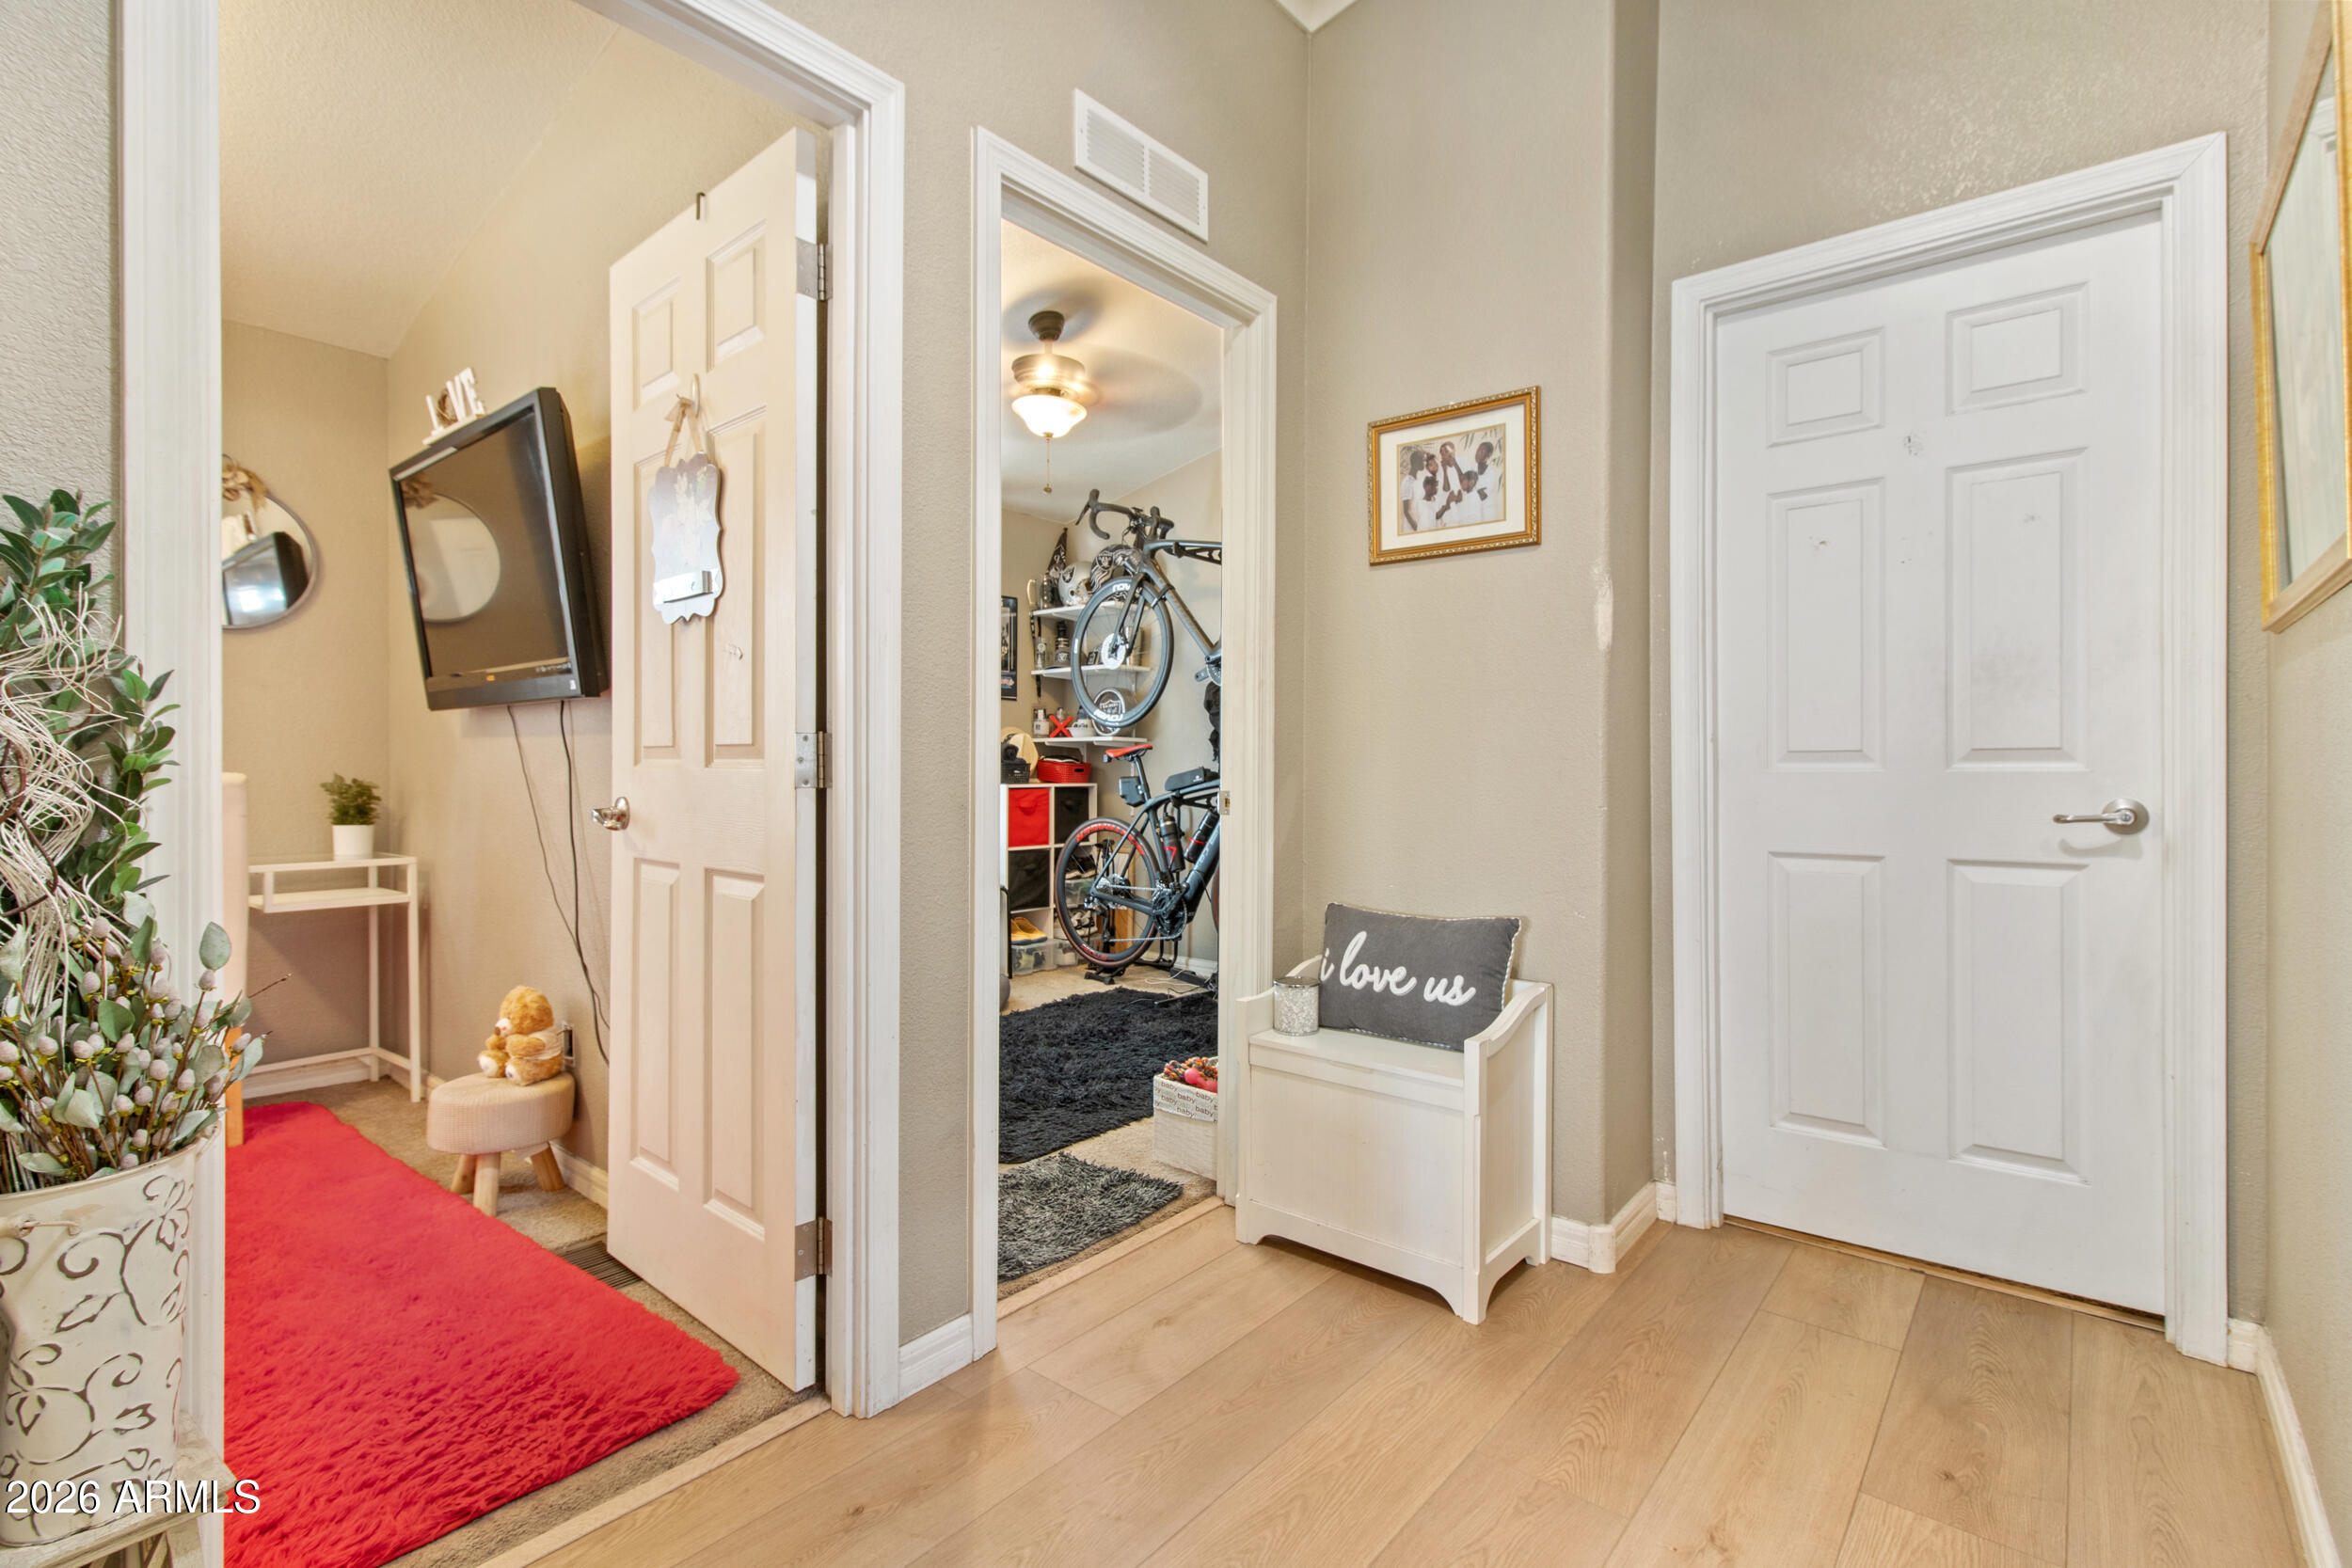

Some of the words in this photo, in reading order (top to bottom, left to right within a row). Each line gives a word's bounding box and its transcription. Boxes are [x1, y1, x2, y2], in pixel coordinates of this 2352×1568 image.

[425, 367, 485, 436] LOVE
[1340, 931, 1418, 995] love
[1423, 974, 1477, 1006] us
